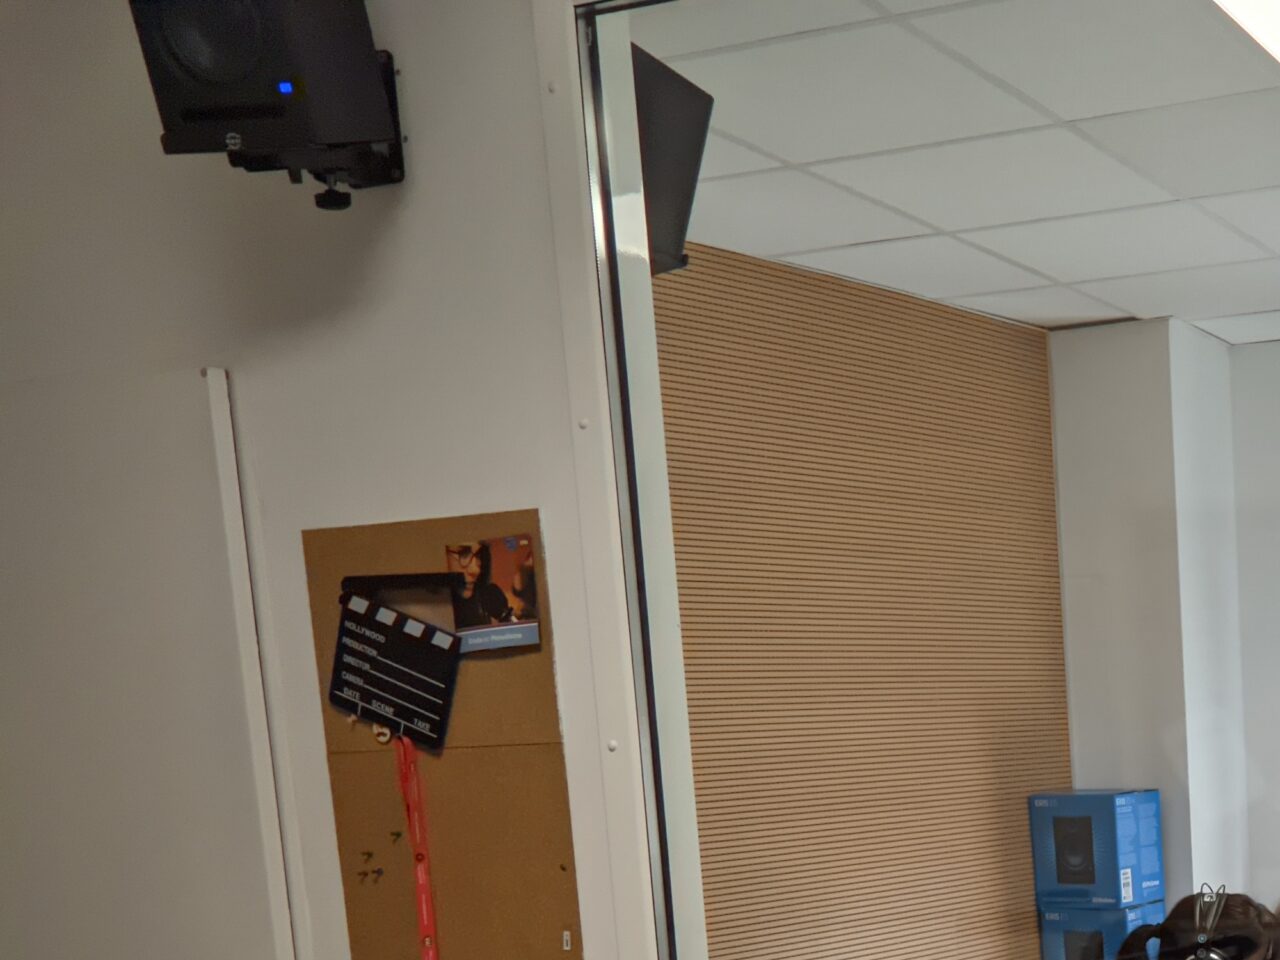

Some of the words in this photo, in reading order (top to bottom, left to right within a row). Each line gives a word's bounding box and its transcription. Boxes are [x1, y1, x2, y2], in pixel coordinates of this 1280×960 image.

[344, 620, 386, 643] HOLLYWOOD
[343, 687, 360, 700] DATE
[371, 700, 395, 715] SCENE
[413, 718, 431, 731] TAKE
